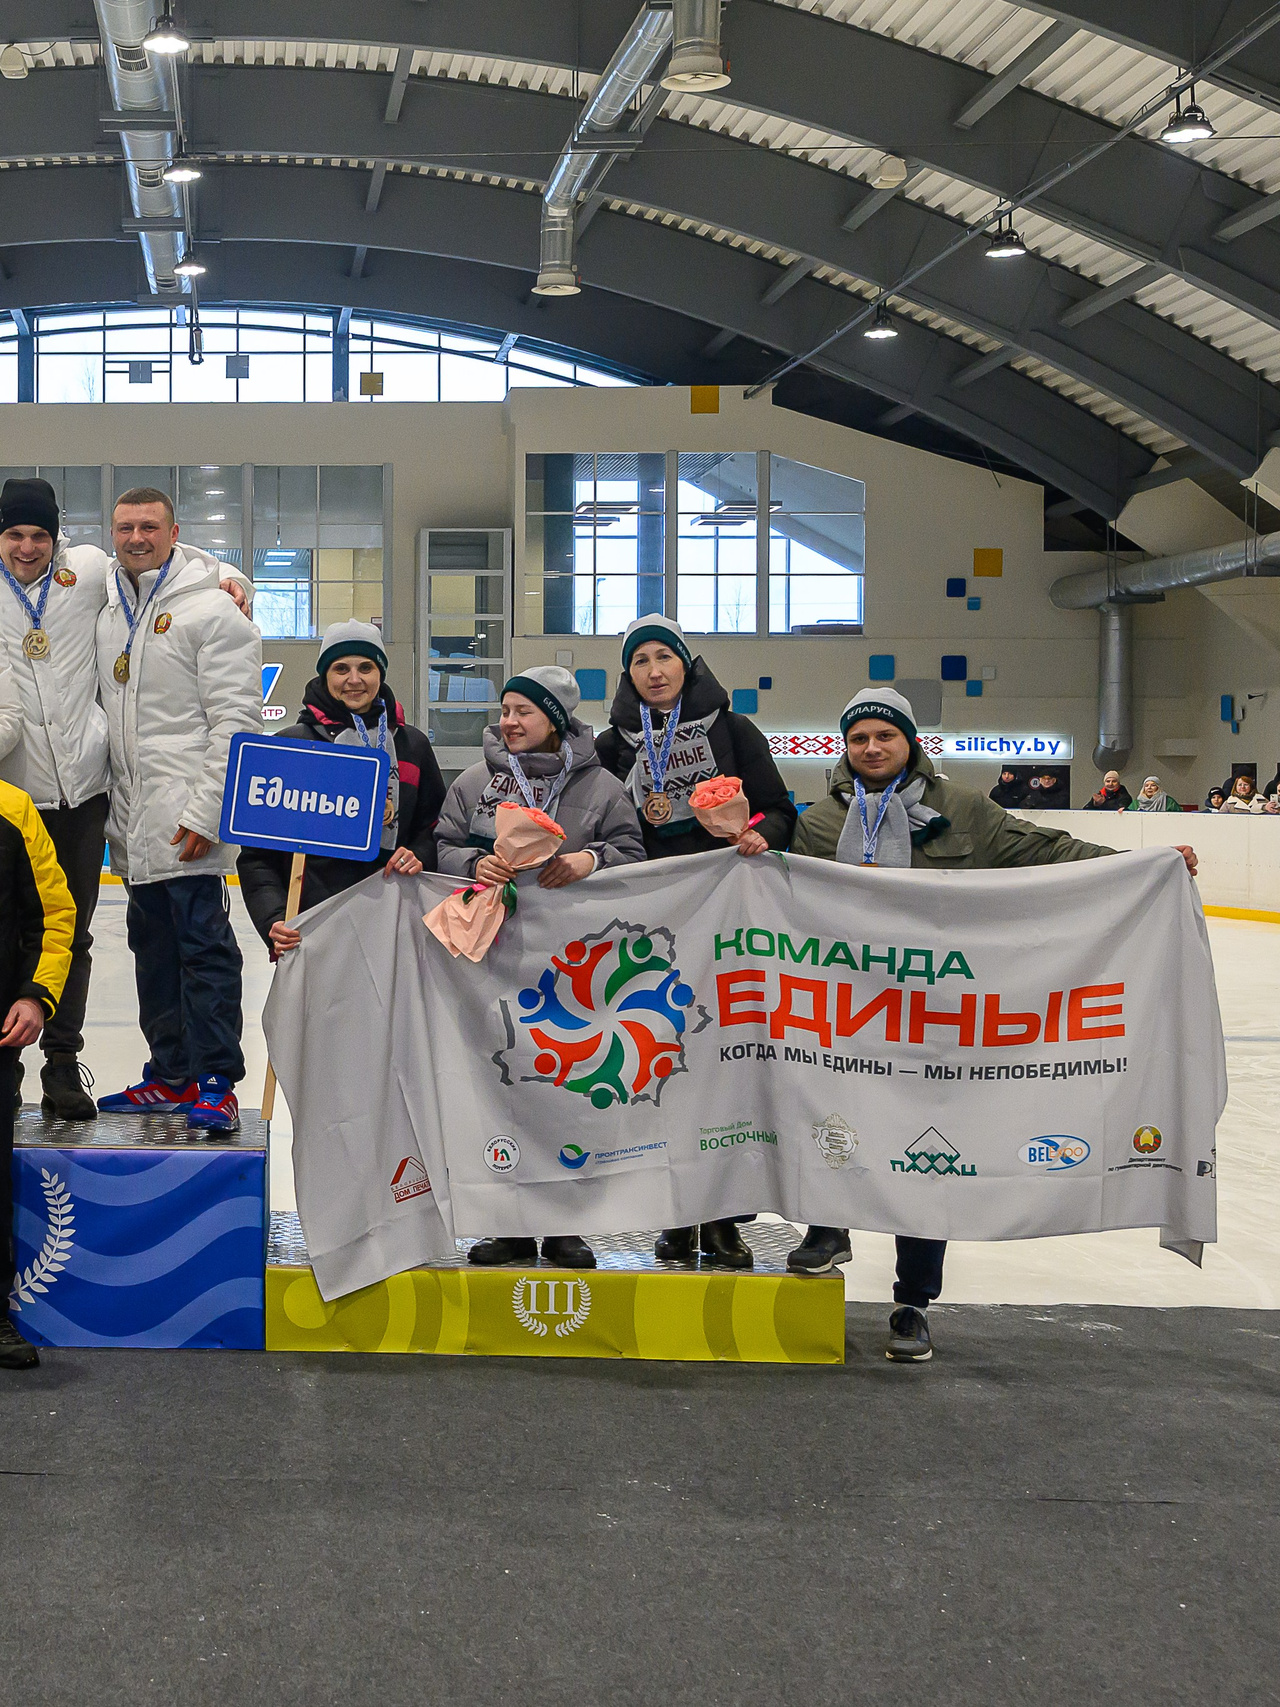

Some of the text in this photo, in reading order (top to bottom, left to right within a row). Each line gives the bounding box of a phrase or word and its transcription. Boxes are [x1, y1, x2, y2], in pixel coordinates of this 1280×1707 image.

[261, 709, 283, 717] НТР
[642, 745, 707, 776] ЕИНЫЕ
[955, 737, 1061, 755] silichy.by
[248, 776, 360, 818] Единые
[490, 774, 544, 802] ЕДИЕ
[714, 927, 975, 985] КОМАНДА
[716, 969, 1126, 1048] ЕДИНЫЕ
[720, 1042, 777, 1062] КОГДА
[784, 1046, 818, 1066] МЫ
[823, 1053, 892, 1076] ЕДИНЫ
[924, 1064, 962, 1080] МЫ
[969, 1057, 1128, 1081] НЕПОБЕДИМЫ!
[595, 1141, 668, 1159] ПРОМТРАНСИНВЕСТ
[700, 1130, 778, 1151] ВОСТОЧНЫЙ
[394, 1180, 431, 1200] ДОМ ПЕЧАТ
[526, 1280, 578, 1315] III
